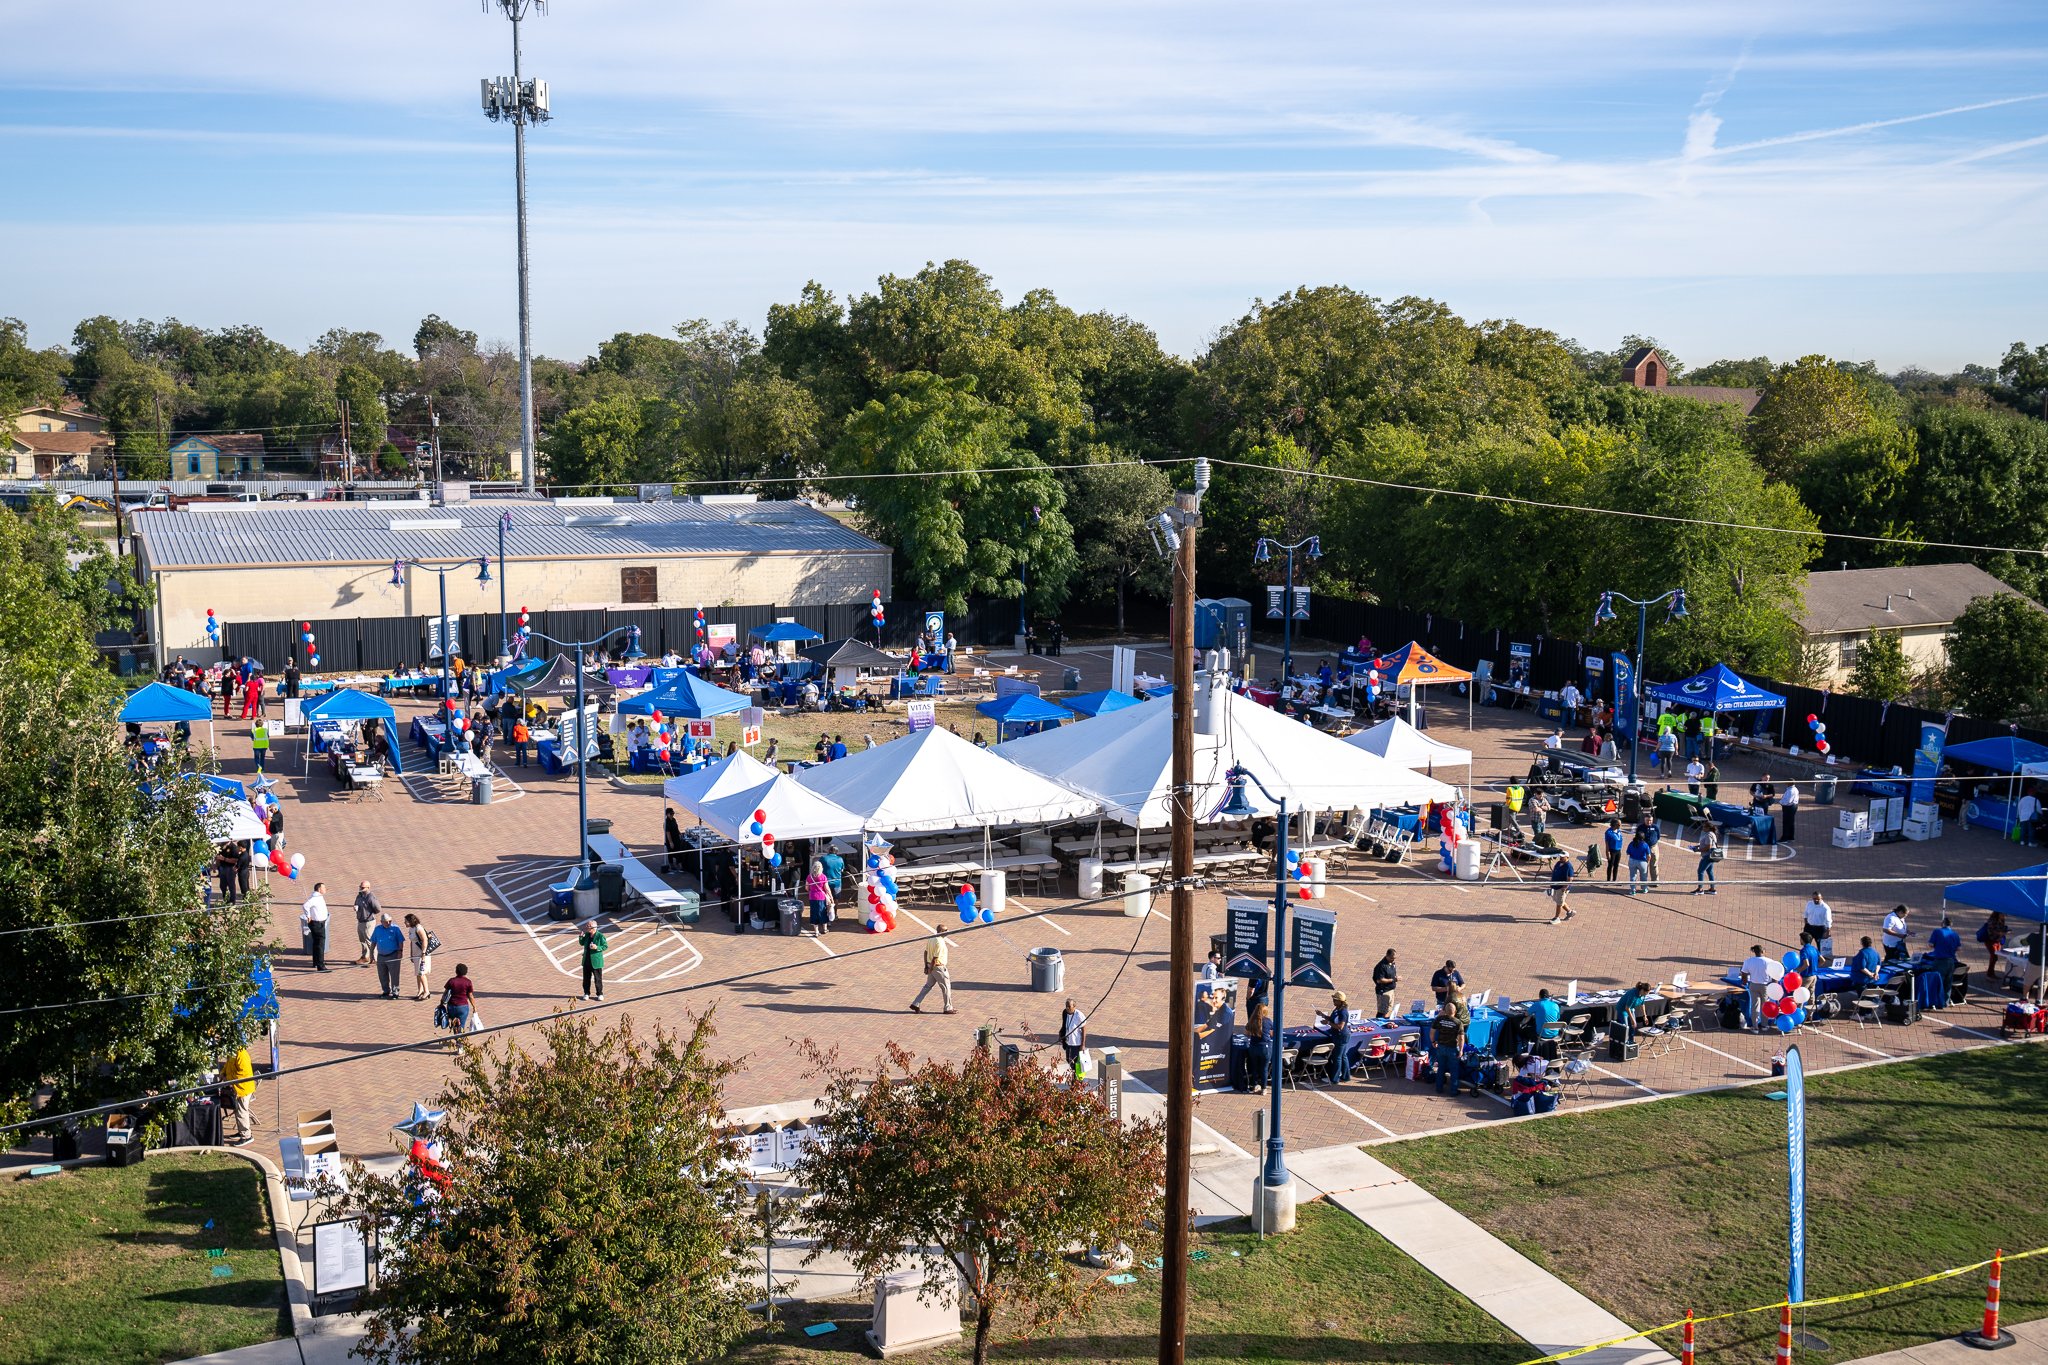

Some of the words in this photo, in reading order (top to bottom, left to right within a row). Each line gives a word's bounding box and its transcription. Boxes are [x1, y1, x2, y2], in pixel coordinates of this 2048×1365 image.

[1235, 917, 1259, 925] Samaritan
[1300, 926, 1323, 936] Samaritan
[1235, 936, 1257, 944] Transition
[1300, 933, 1320, 941] Veterans
[1299, 939, 1319, 948] Outreach
[1299, 946, 1322, 954] Transition
[1109, 1079, 1118, 1119] EMERG
